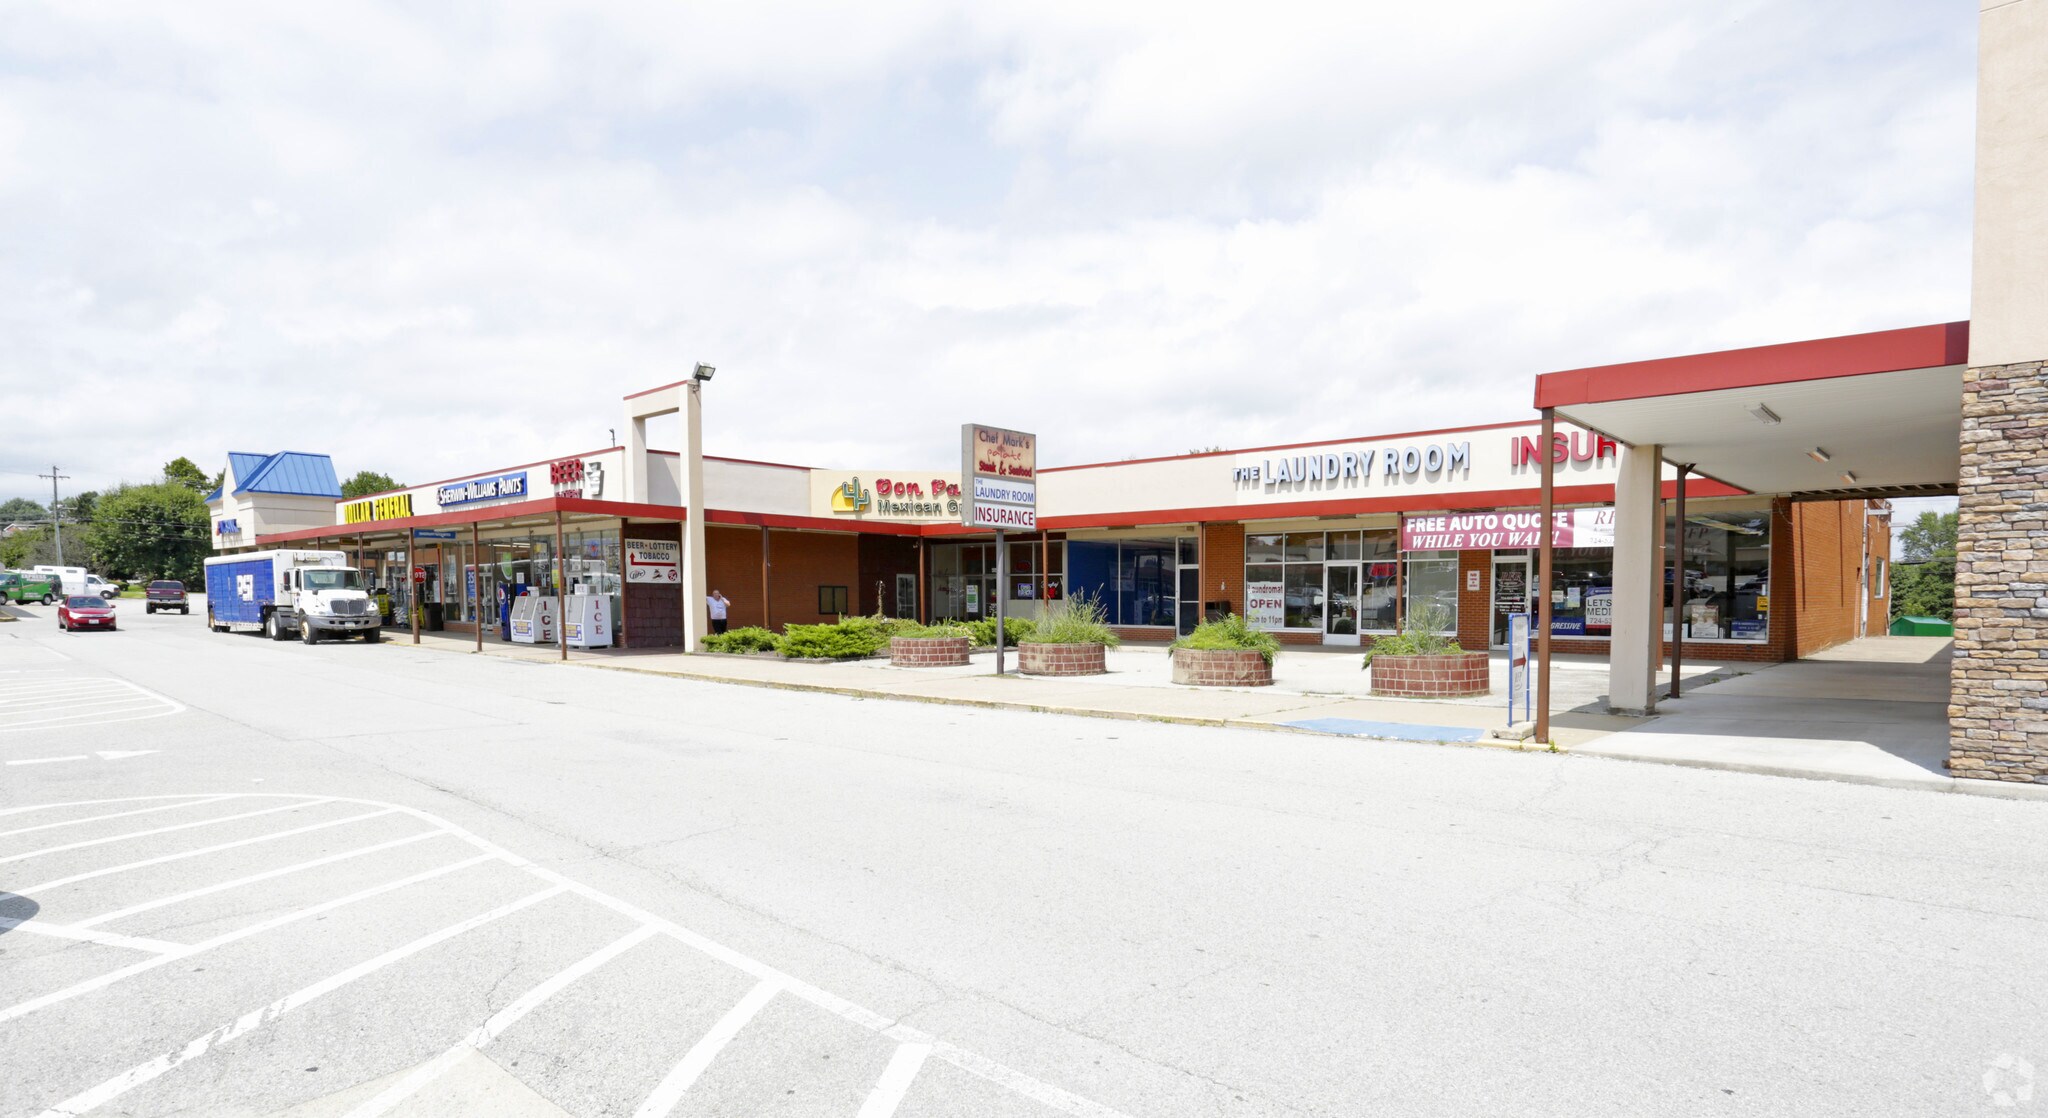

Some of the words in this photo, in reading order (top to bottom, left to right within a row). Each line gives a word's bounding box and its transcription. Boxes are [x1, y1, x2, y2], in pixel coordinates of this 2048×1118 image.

[979, 430, 998, 444] Chef
[1003, 433, 1030, 449] Mark's
[1511, 431, 1617, 466] INSUR
[987, 448, 1021, 462] palate
[1233, 466, 1260, 481] THE
[1263, 450, 1375, 484] LAUNDRY
[1383, 442, 1470, 475] ROOM
[550, 459, 584, 485] BEER
[979, 460, 997, 473] Steak
[998, 460, 1007, 476] &
[1008, 464, 1032, 477] Seafood
[440, 482, 497, 505] SHERWIN-WILLIAMS
[498, 477, 523, 498] PAINTS
[876, 478, 923, 496] Don
[931, 479, 961, 496] Pa
[975, 486, 1010, 500] LAUNDRY
[1012, 490, 1034, 503] ROOM
[344, 501, 372, 525] DOLLAR
[374, 494, 412, 520] GENERAL
[877, 499, 942, 513] Mexican
[975, 506, 1034, 526] INSURANCE
[1406, 517, 1446, 533] FREE
[1449, 514, 1498, 531] AUTO
[1502, 512, 1568, 531] QUOE
[627, 541, 645, 549] BEER
[649, 542, 678, 550] LOTTERY
[1412, 534, 1464, 548] WHILE
[1469, 532, 1504, 547] YOU
[1508, 530, 1560, 546] WAI!
[639, 551, 670, 560] TOBACCO
[1250, 599, 1282, 608] OPEN
[1587, 599, 1613, 607] LET'S
[1587, 608, 1612, 616] MEDI
[541, 601, 551, 641] ICE
[594, 599, 604, 635] ICE
